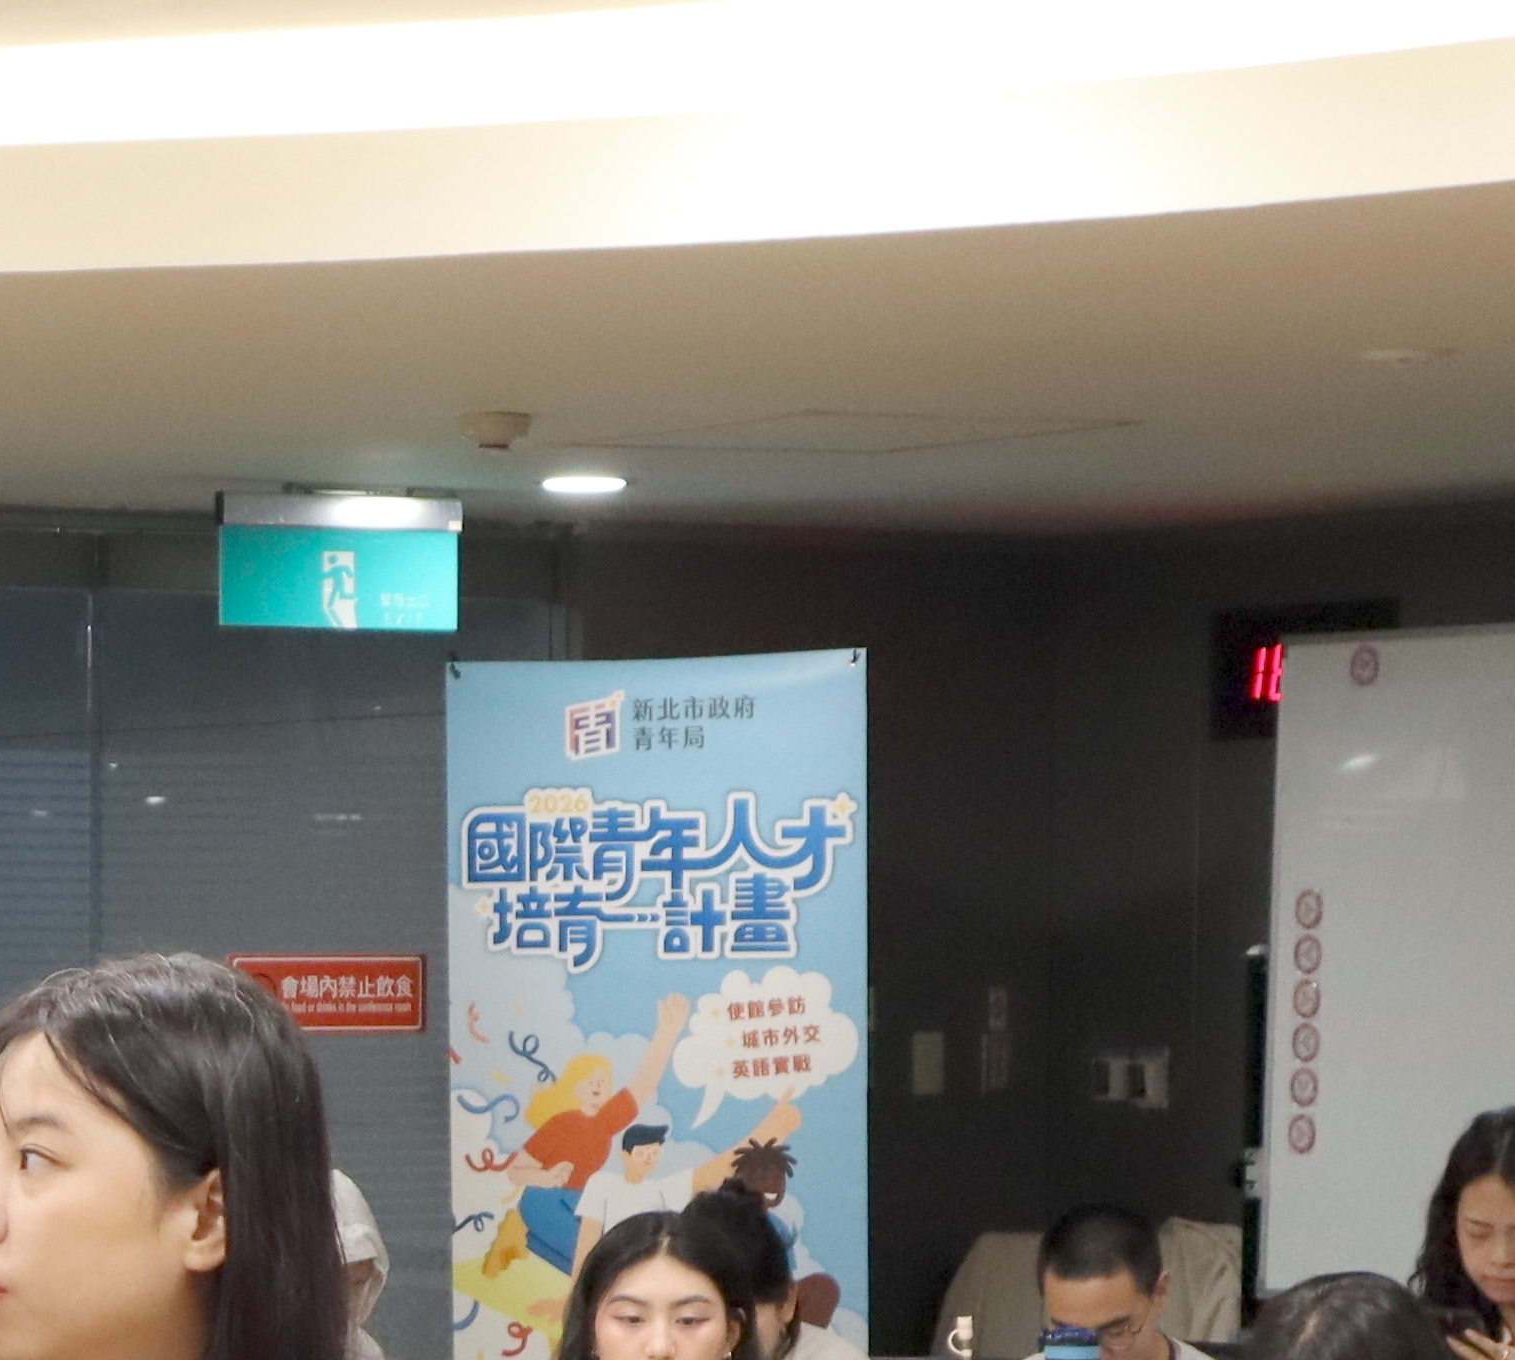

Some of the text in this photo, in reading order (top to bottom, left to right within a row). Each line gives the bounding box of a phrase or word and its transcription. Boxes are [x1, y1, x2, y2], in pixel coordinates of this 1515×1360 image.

[632, 695, 756, 721] 新北市政府
[633, 726, 705, 751] 青年局
[528, 794, 589, 813] 2026
[465, 795, 849, 902] 國際青年人才
[280, 974, 414, 999] 會場內禁止飲食
[727, 996, 806, 1021] 使館參訪
[742, 1024, 821, 1048] 城市外交
